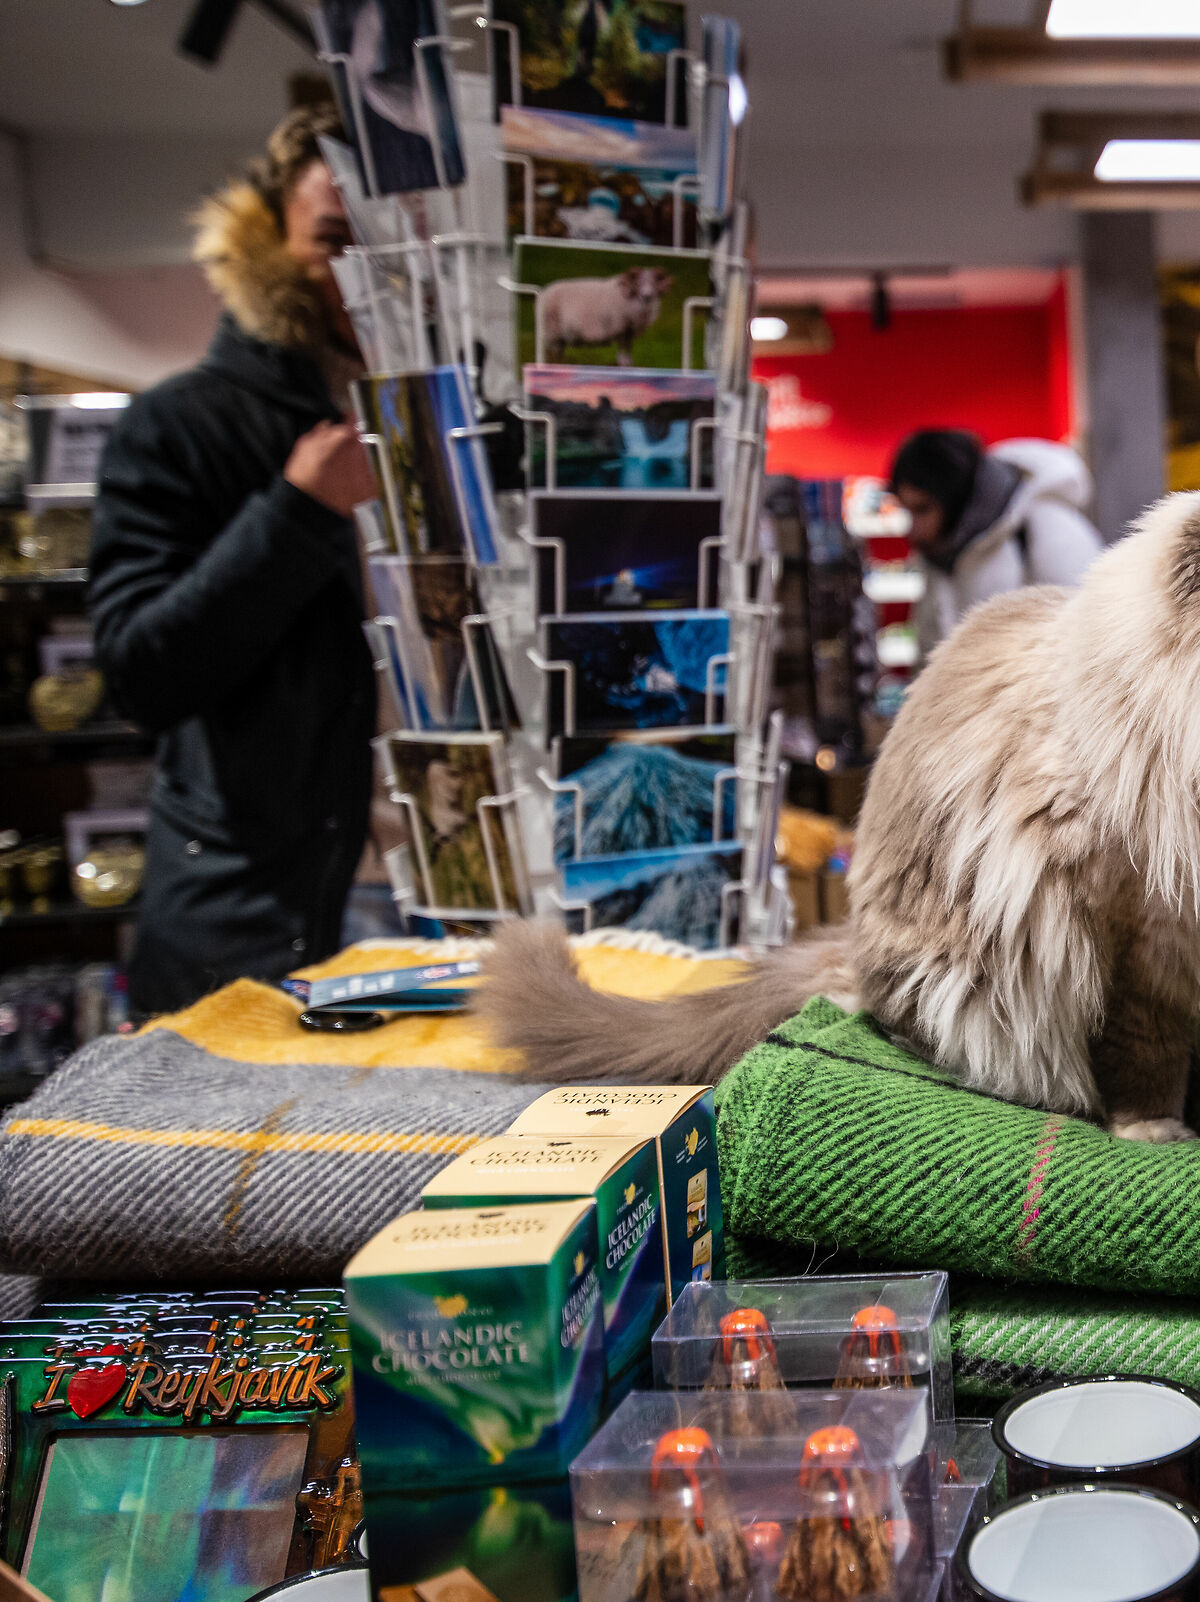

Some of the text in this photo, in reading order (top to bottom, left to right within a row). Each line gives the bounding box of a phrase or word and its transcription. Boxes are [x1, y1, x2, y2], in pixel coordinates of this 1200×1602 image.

[606, 1208, 656, 1269] CHOCOLATE
[608, 1194, 652, 1249] ICELANDIC
[372, 1343, 529, 1373] CHOCOLATE
[380, 1321, 522, 1351] ICELANDIC
[31, 1364, 77, 1413] I
